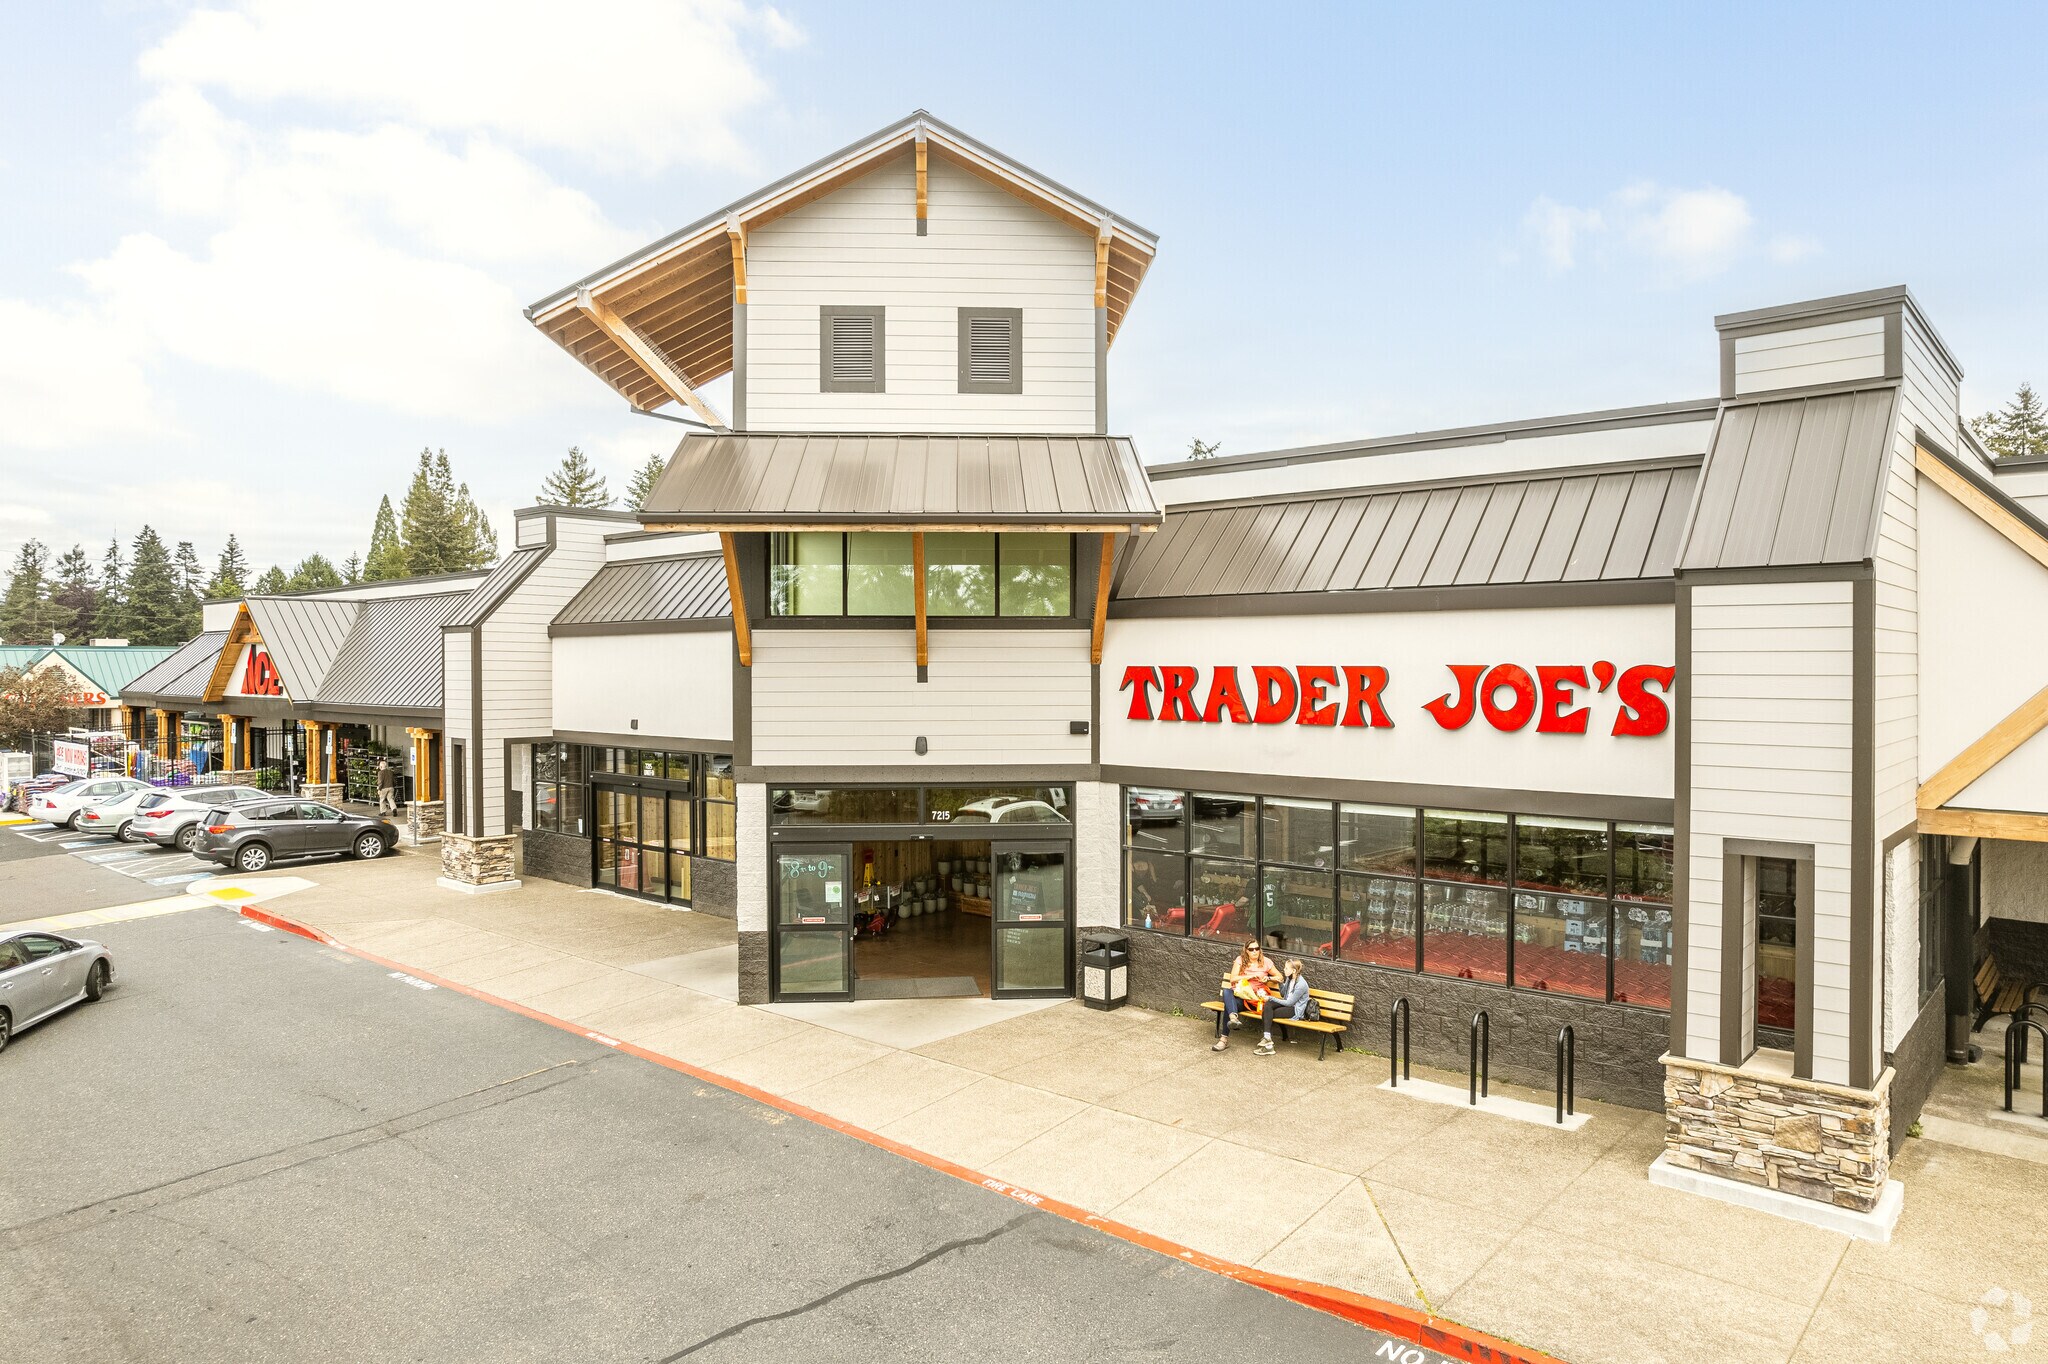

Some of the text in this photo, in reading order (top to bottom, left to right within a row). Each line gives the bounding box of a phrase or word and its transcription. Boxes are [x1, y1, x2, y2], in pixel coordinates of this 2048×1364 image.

[241, 644, 283, 696] ACE
[1119, 660, 1676, 737] TRADER JOE'S
[932, 811, 950, 820] 7215
[1266, 892, 1274, 907] 5
[982, 1179, 1044, 1205] FIRE LANE
[1375, 1340, 1425, 1364] NO
